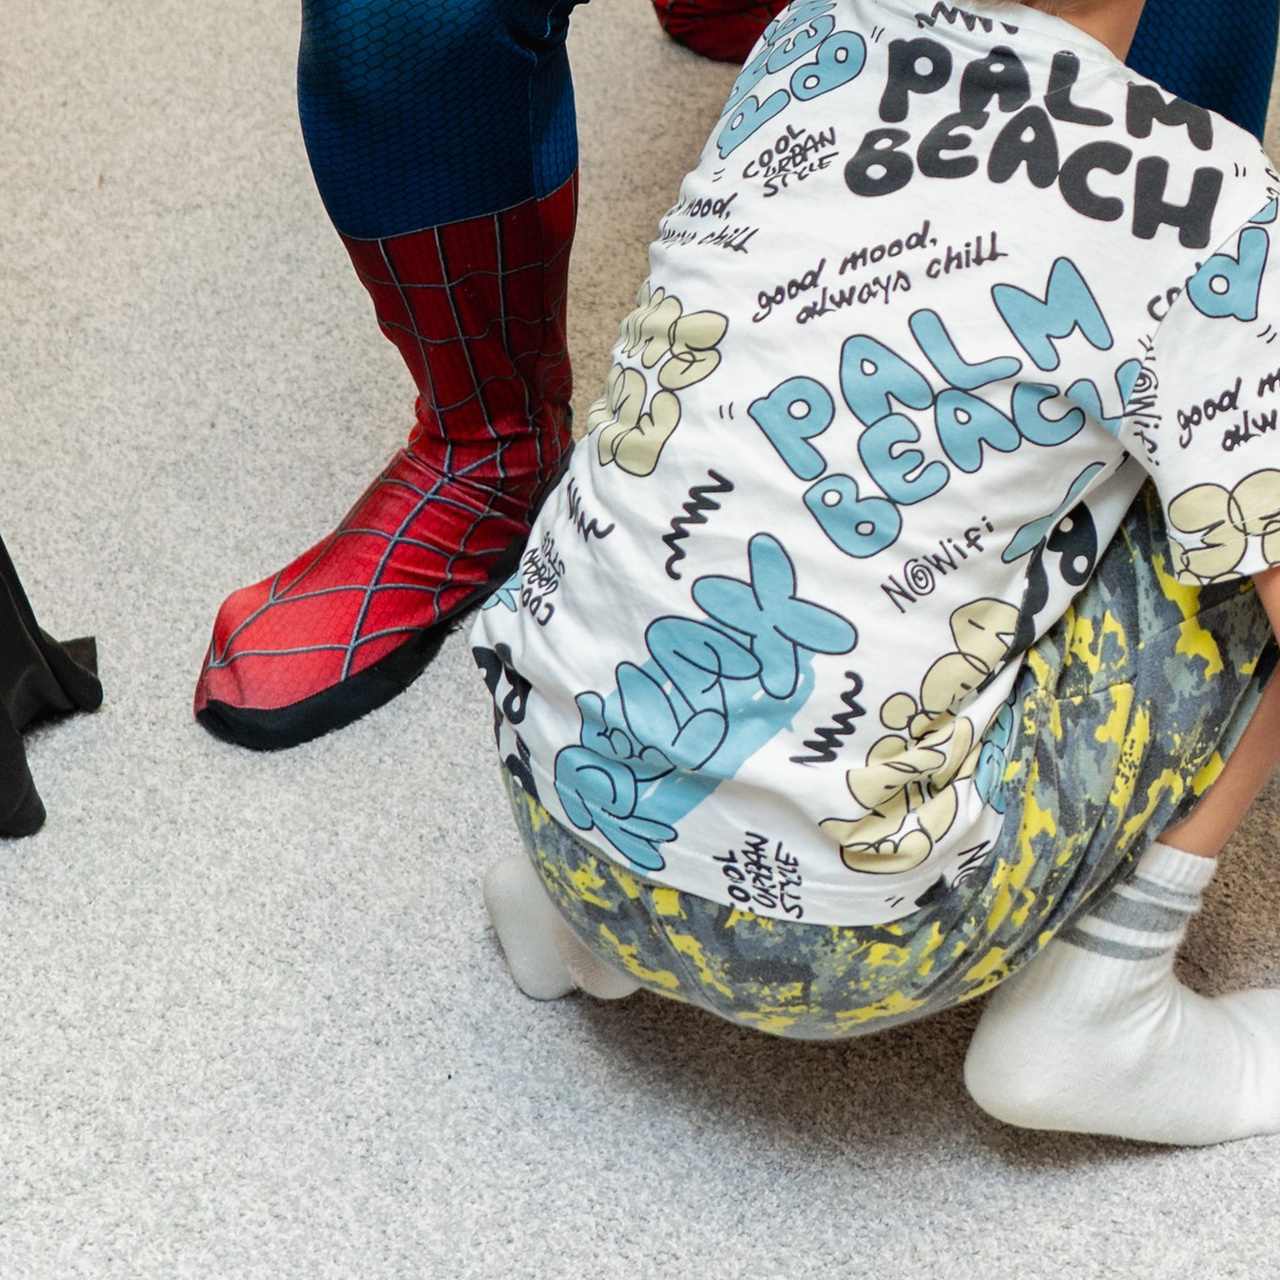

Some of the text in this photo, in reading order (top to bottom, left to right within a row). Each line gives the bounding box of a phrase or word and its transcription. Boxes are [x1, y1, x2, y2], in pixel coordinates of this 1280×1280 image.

[876, 37, 1214, 151] PALM
[742, 124, 806, 179] COOL
[763, 126, 836, 178] URBAN
[763, 151, 840, 198] STYLE
[843, 105, 1225, 250] BEACH
[752, 219, 938, 324] good mood,
[796, 230, 1010, 325] always chill
[747, 256, 1114, 482] PALM
[1176, 376, 1243, 449] good
[803, 357, 1144, 559] BEACH
[554, 532, 860, 872] RELAX
